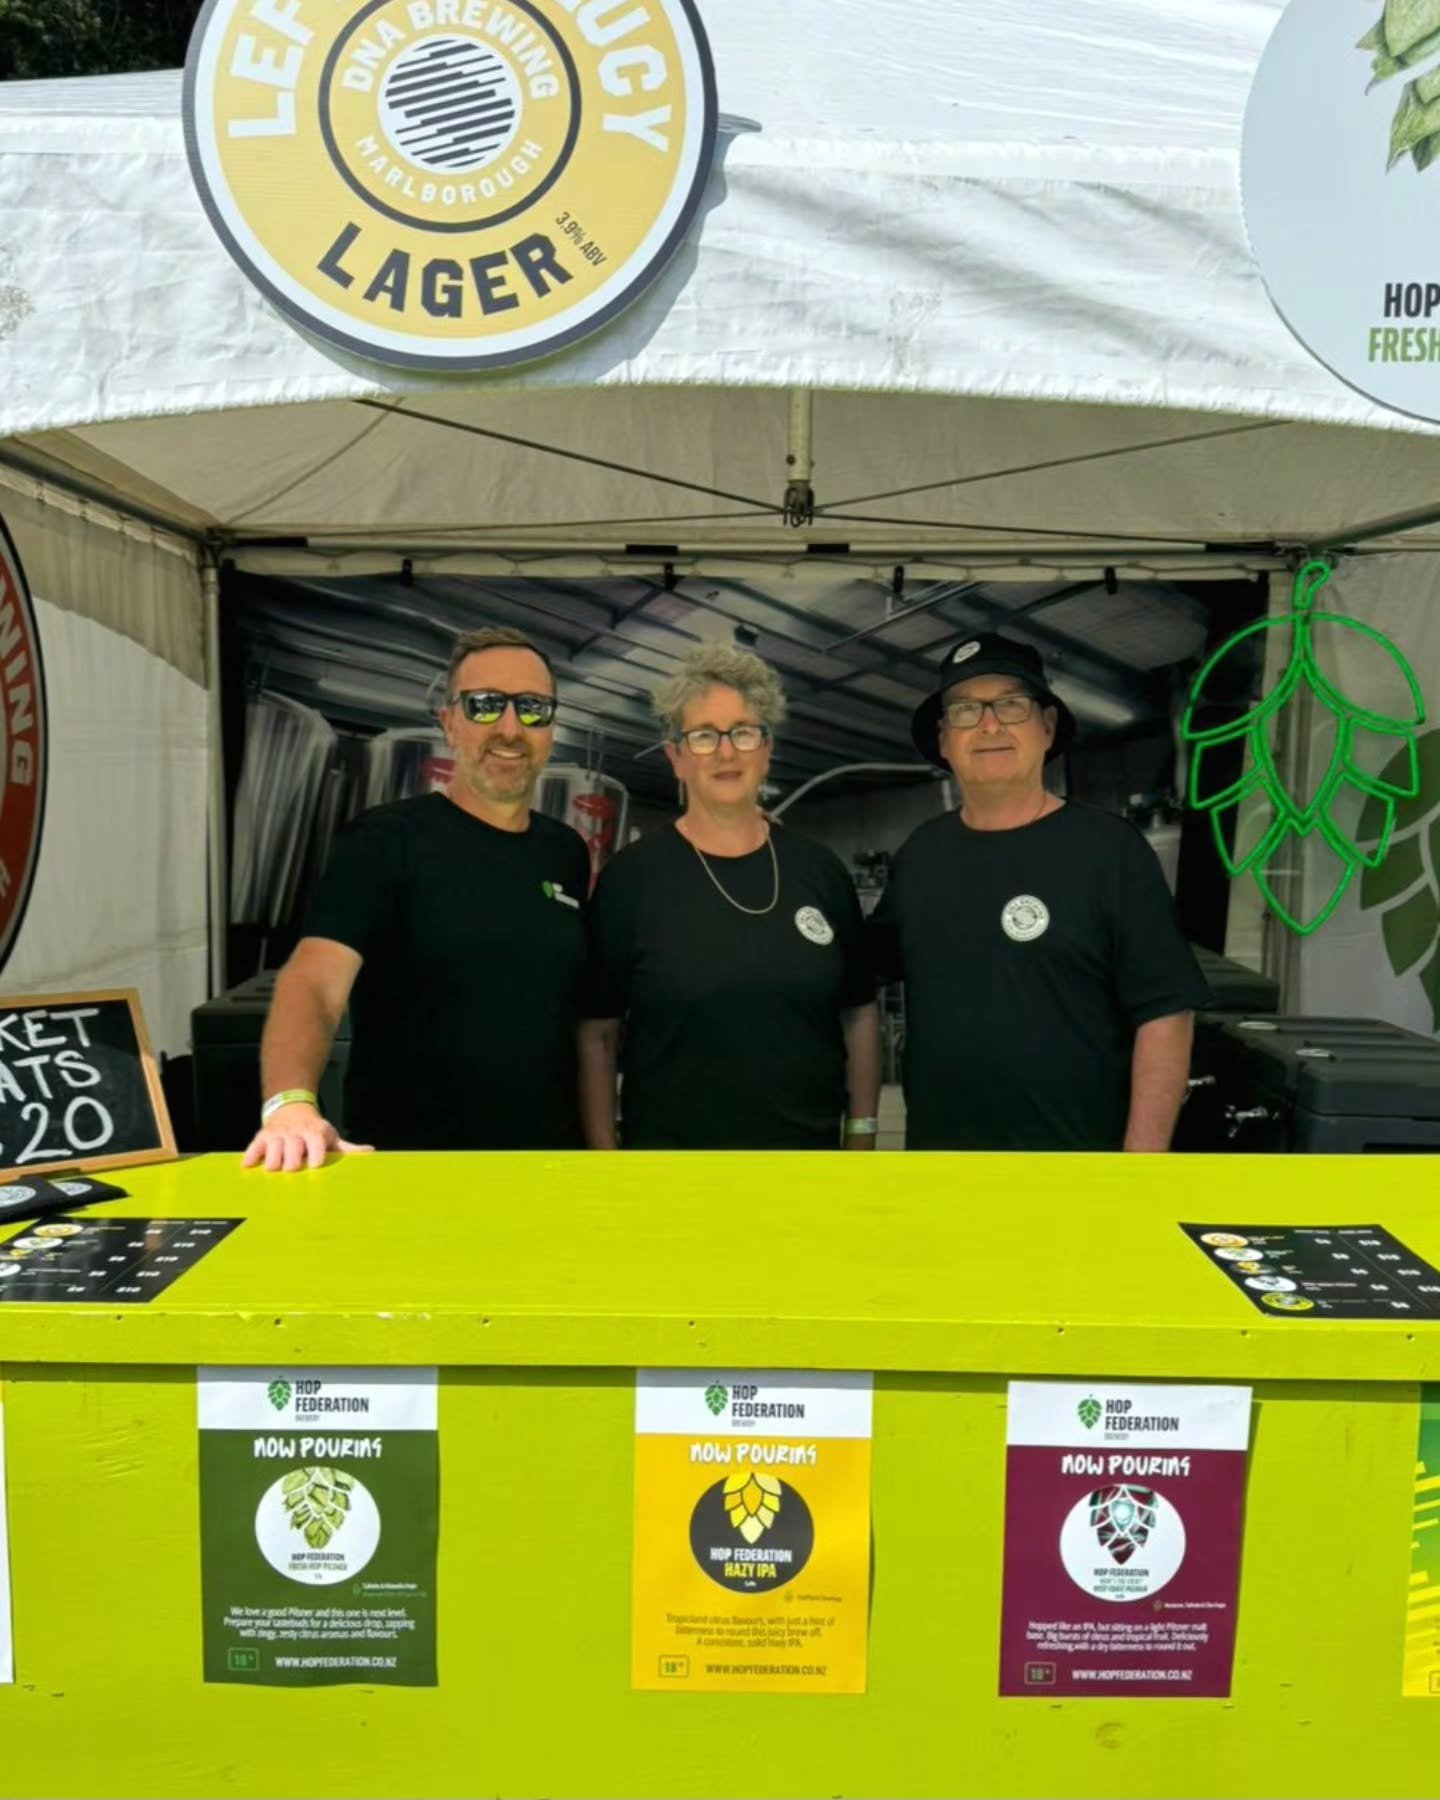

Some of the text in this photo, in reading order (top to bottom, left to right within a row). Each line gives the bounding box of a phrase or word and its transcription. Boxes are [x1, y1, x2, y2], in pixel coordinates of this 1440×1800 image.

[342, 0, 560, 101] DNA BREWING
[229, 0, 673, 153] LEF UCY
[355, 134, 544, 206] MARLBOROUGH
[555, 211, 608, 268] 3.9% ABV
[317, 222, 575, 319] LAGER
[1384, 282, 1440, 318] HOP
[0, 1095, 114, 1164] 20
[295, 1380, 322, 1395] HOP
[731, 1385, 758, 1400] HOP
[295, 1397, 369, 1413] FEDERATION
[731, 1402, 805, 1419] FEDERATION
[1105, 1399, 1133, 1414] HOP
[1104, 1416, 1179, 1432] FEDERATION
[253, 1437, 296, 1458] NOW
[690, 1442, 732, 1464] NOW
[1061, 1453, 1105, 1475] NOW
[710, 1547, 792, 1563] HOP FEDERATION
[724, 1562, 777, 1578] HAZY IPA
